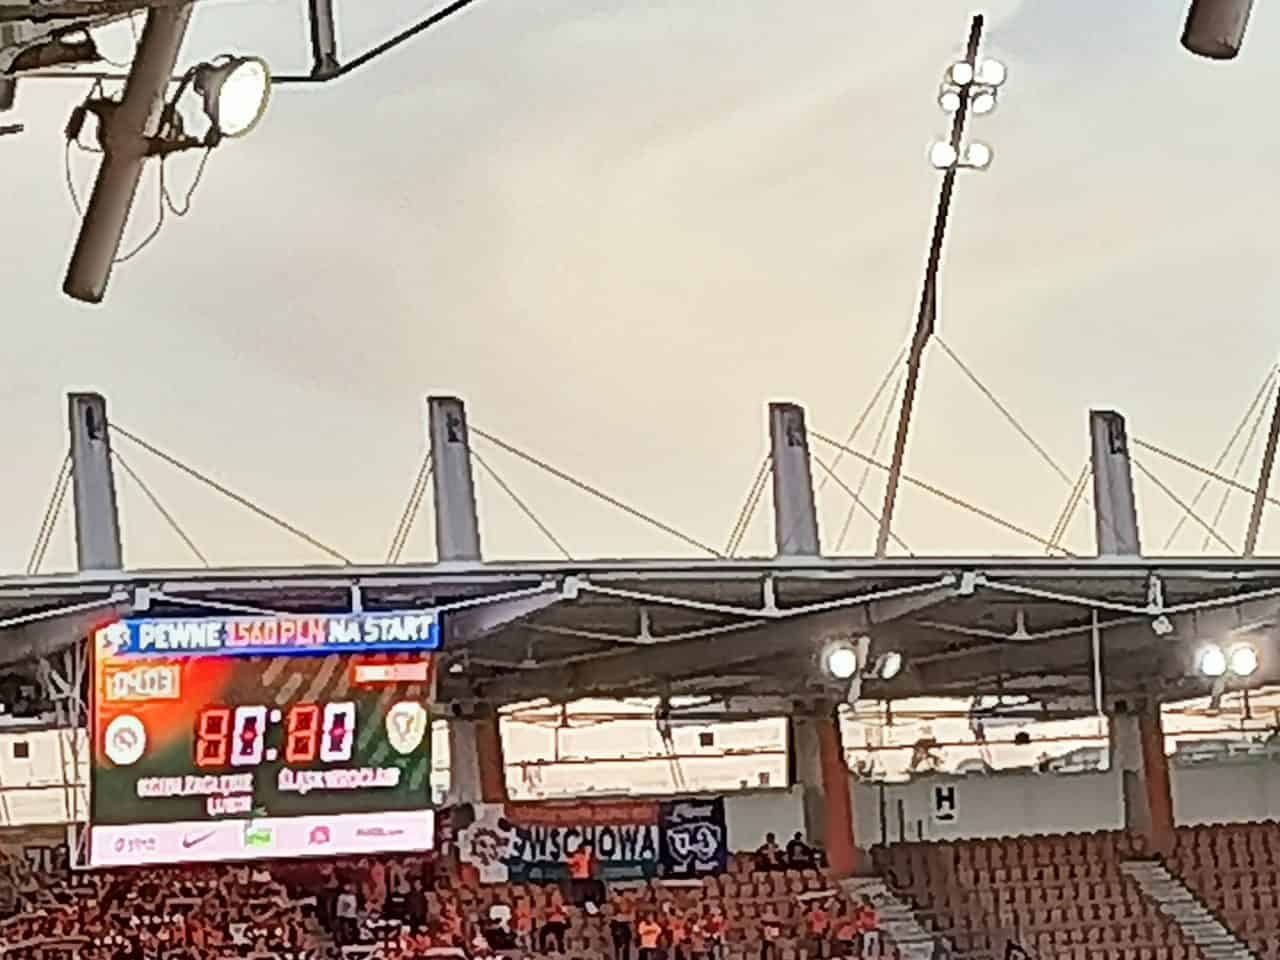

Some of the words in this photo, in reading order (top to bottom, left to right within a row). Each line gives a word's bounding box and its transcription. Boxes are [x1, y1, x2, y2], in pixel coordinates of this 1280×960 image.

[140, 622, 221, 649] PEWNE
[280, 620, 325, 645] PLN
[329, 619, 360, 642] NA
[364, 615, 433, 641] START
[935, 786, 954, 811] H
